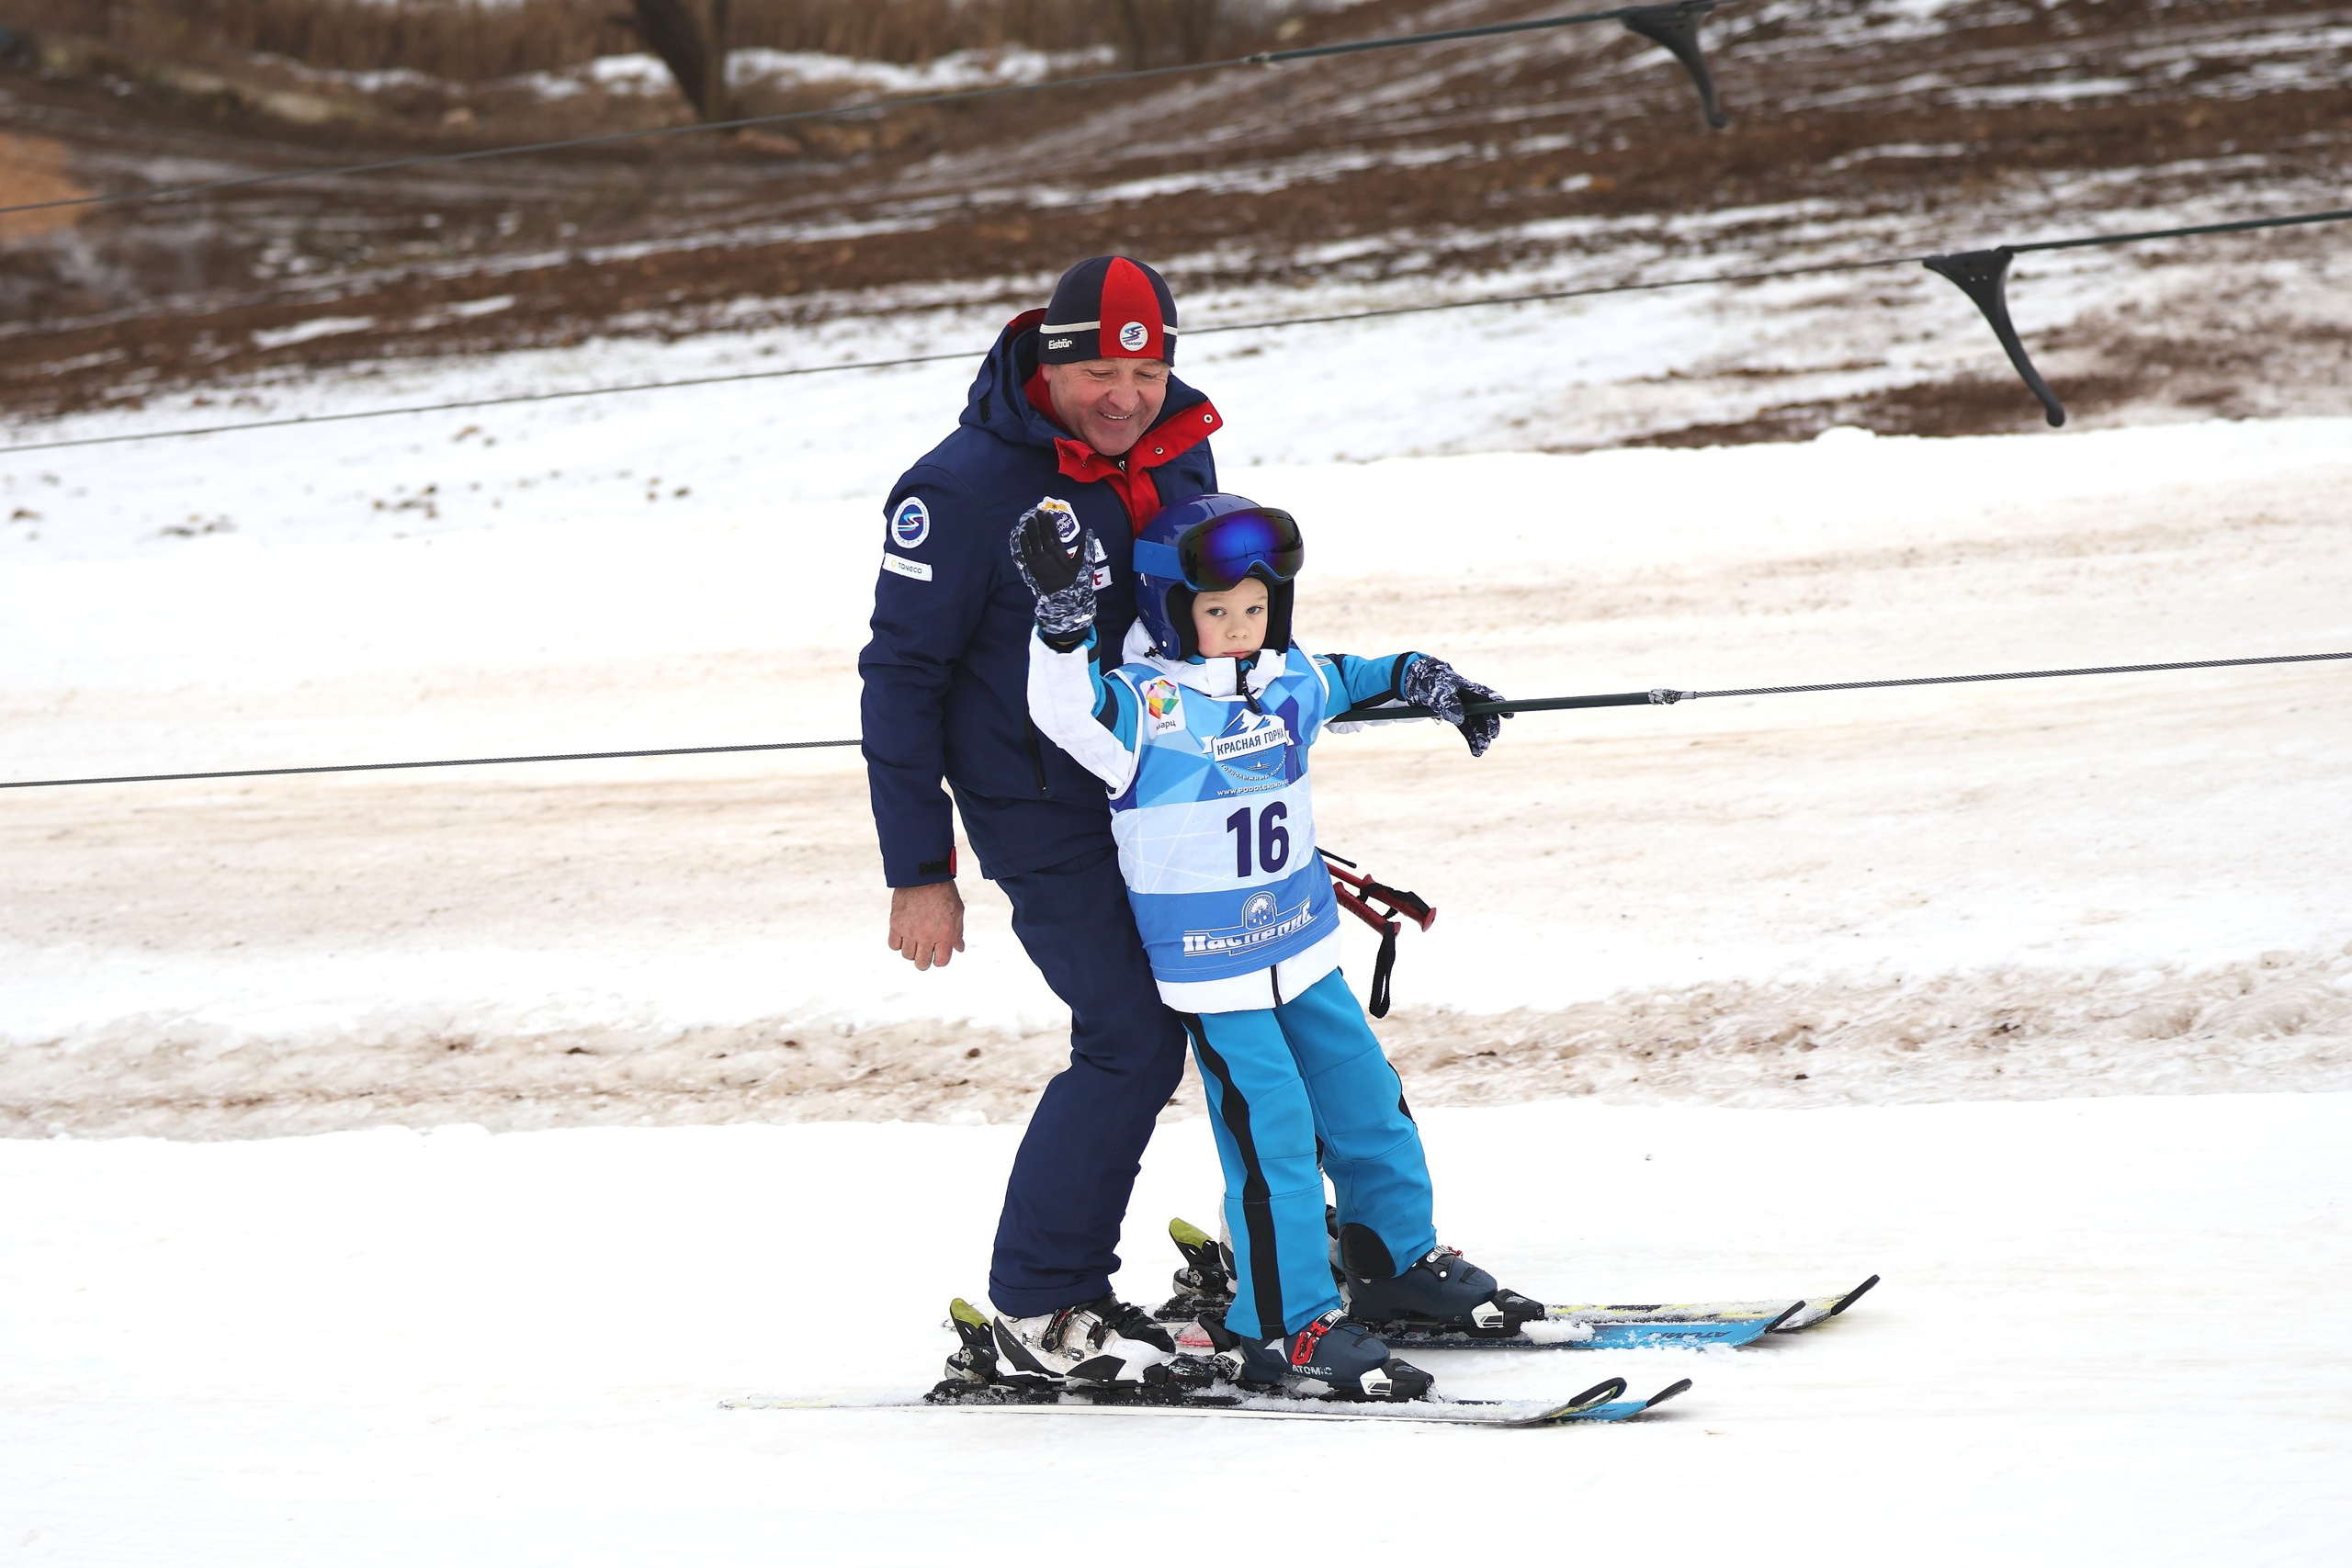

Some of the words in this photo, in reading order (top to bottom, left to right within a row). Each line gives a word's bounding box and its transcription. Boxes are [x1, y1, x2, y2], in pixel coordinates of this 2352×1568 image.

[1048, 338, 1073, 350] Eisbär
[1216, 735, 1261, 756] КРАСНАЯ
[1220, 763, 1271, 781] ГОРНОЛЫЖНЫЙ
[1227, 801, 1289, 878] 16
[1292, 1364, 1333, 1376] ATOMIC
